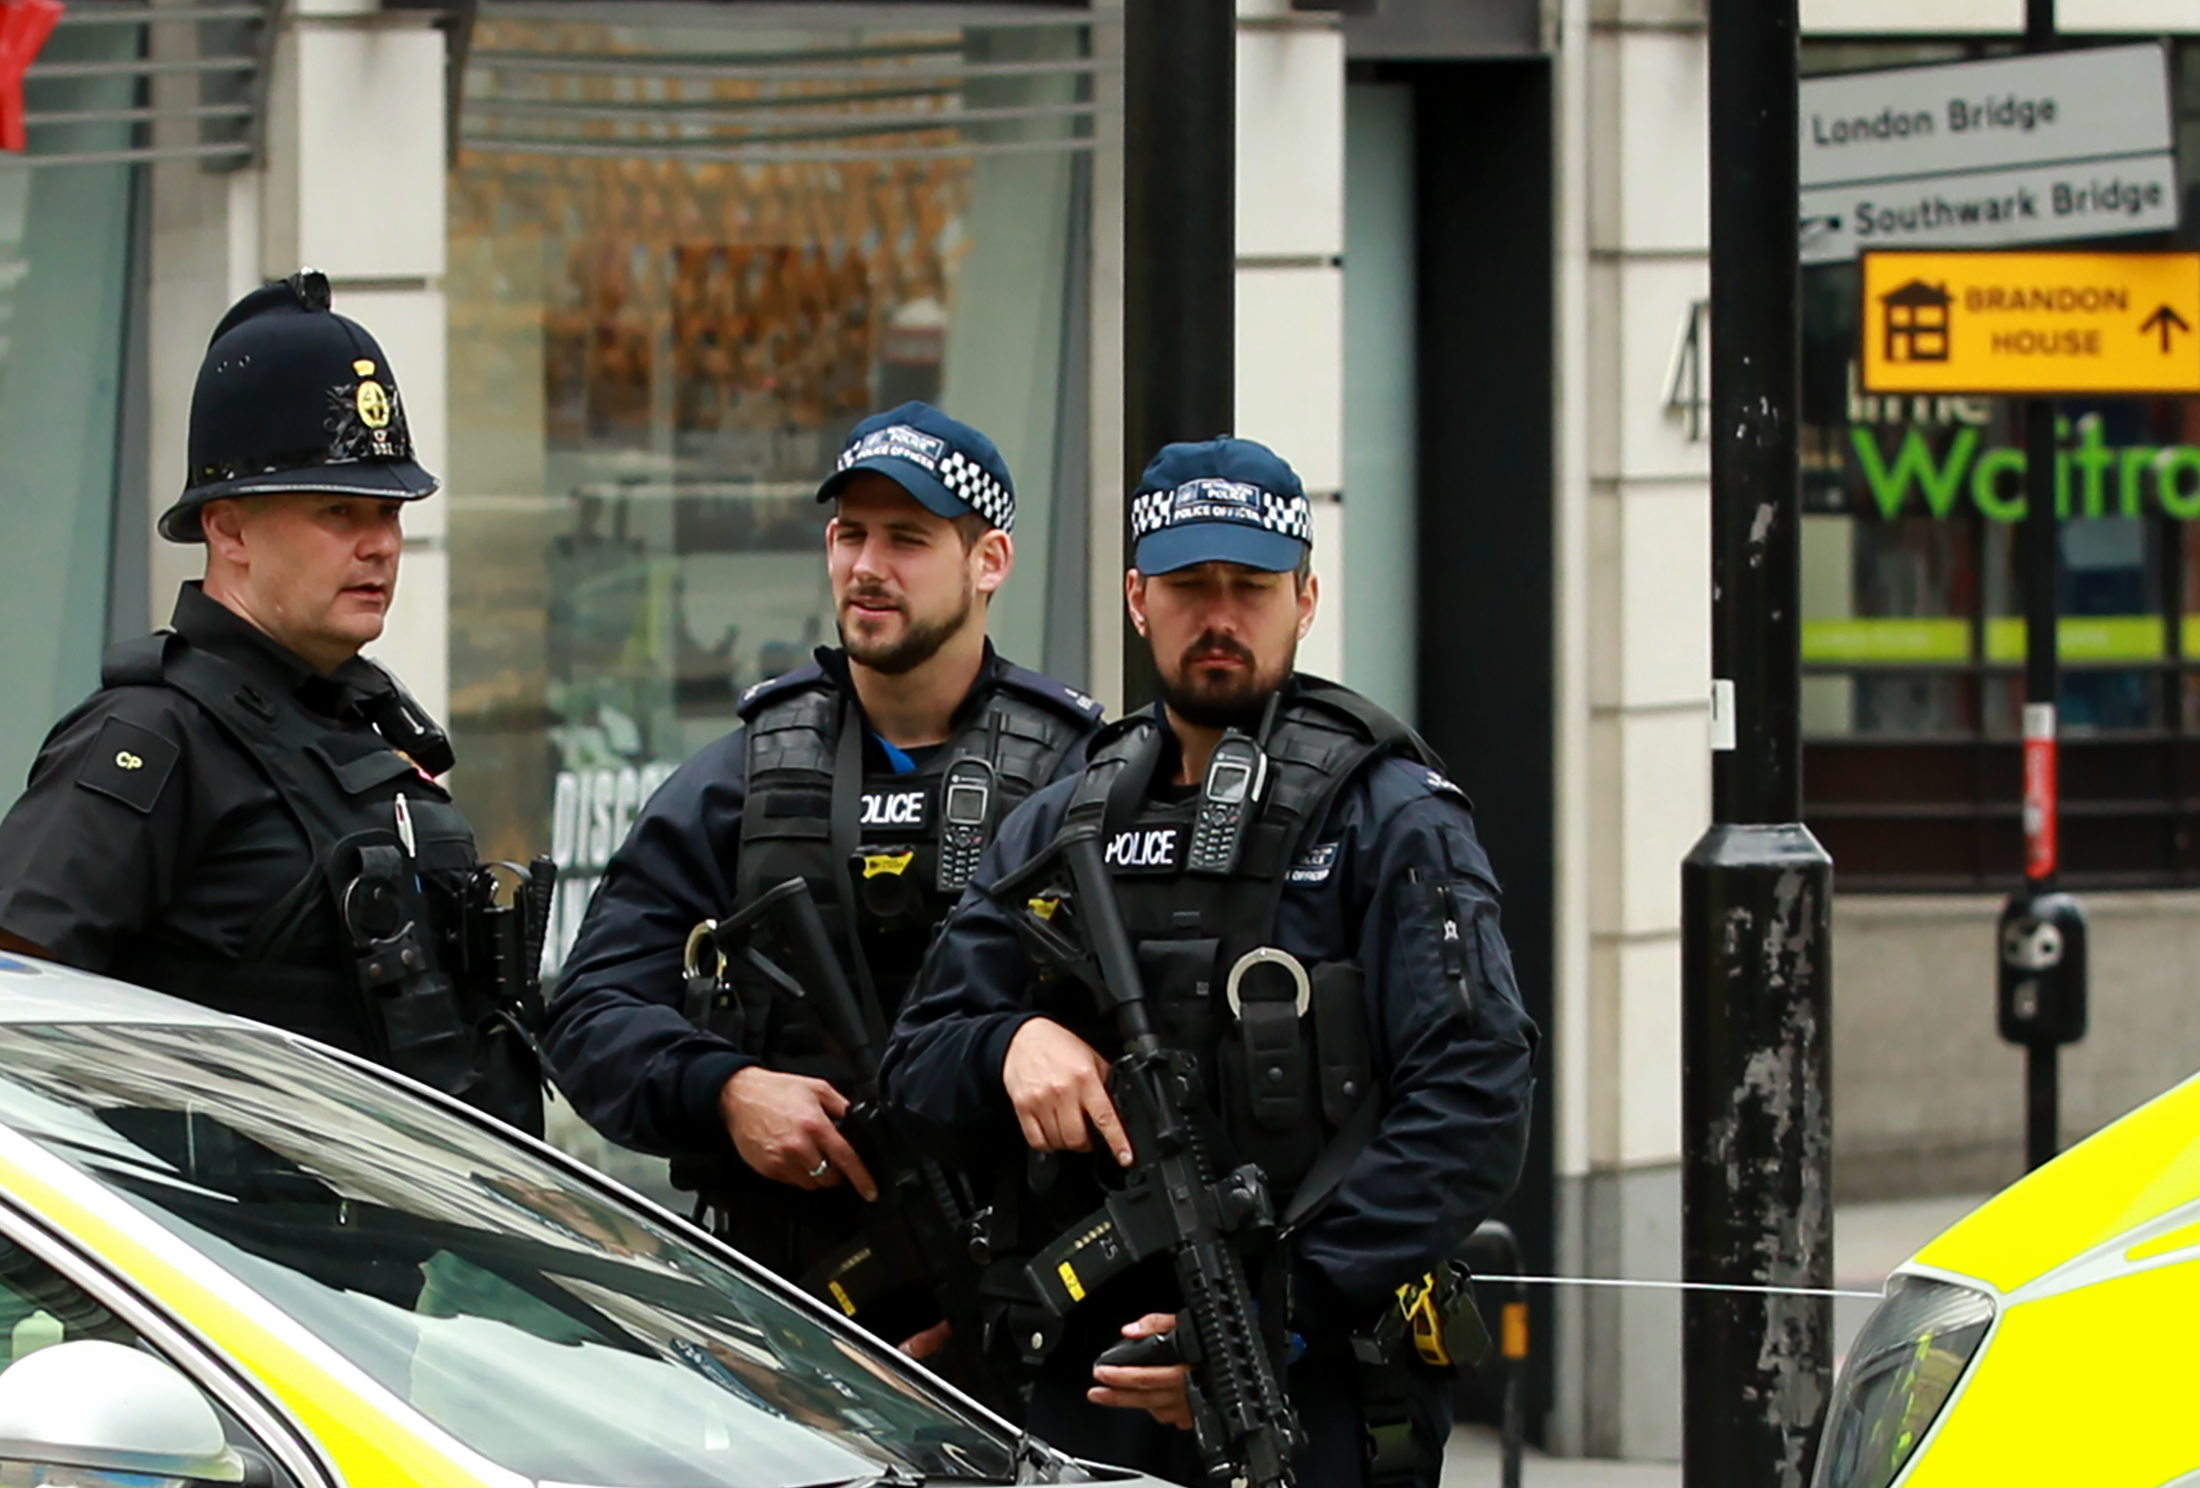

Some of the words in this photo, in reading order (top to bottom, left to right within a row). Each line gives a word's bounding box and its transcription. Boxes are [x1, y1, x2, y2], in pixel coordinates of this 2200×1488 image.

[1811, 104, 1936, 148] London
[1947, 96, 2059, 134] Bridge
[1855, 185, 2038, 236] Southwark
[2051, 178, 2164, 216] Bridge
[1964, 285, 2129, 314] BRANDON
[1990, 329, 2102, 356] HOUSE
[1174, 503, 1211, 521] POLICE
[115, 750, 144, 770] CP
[860, 791, 925, 824] OLICE
[1104, 830, 1177, 866] POLICE
